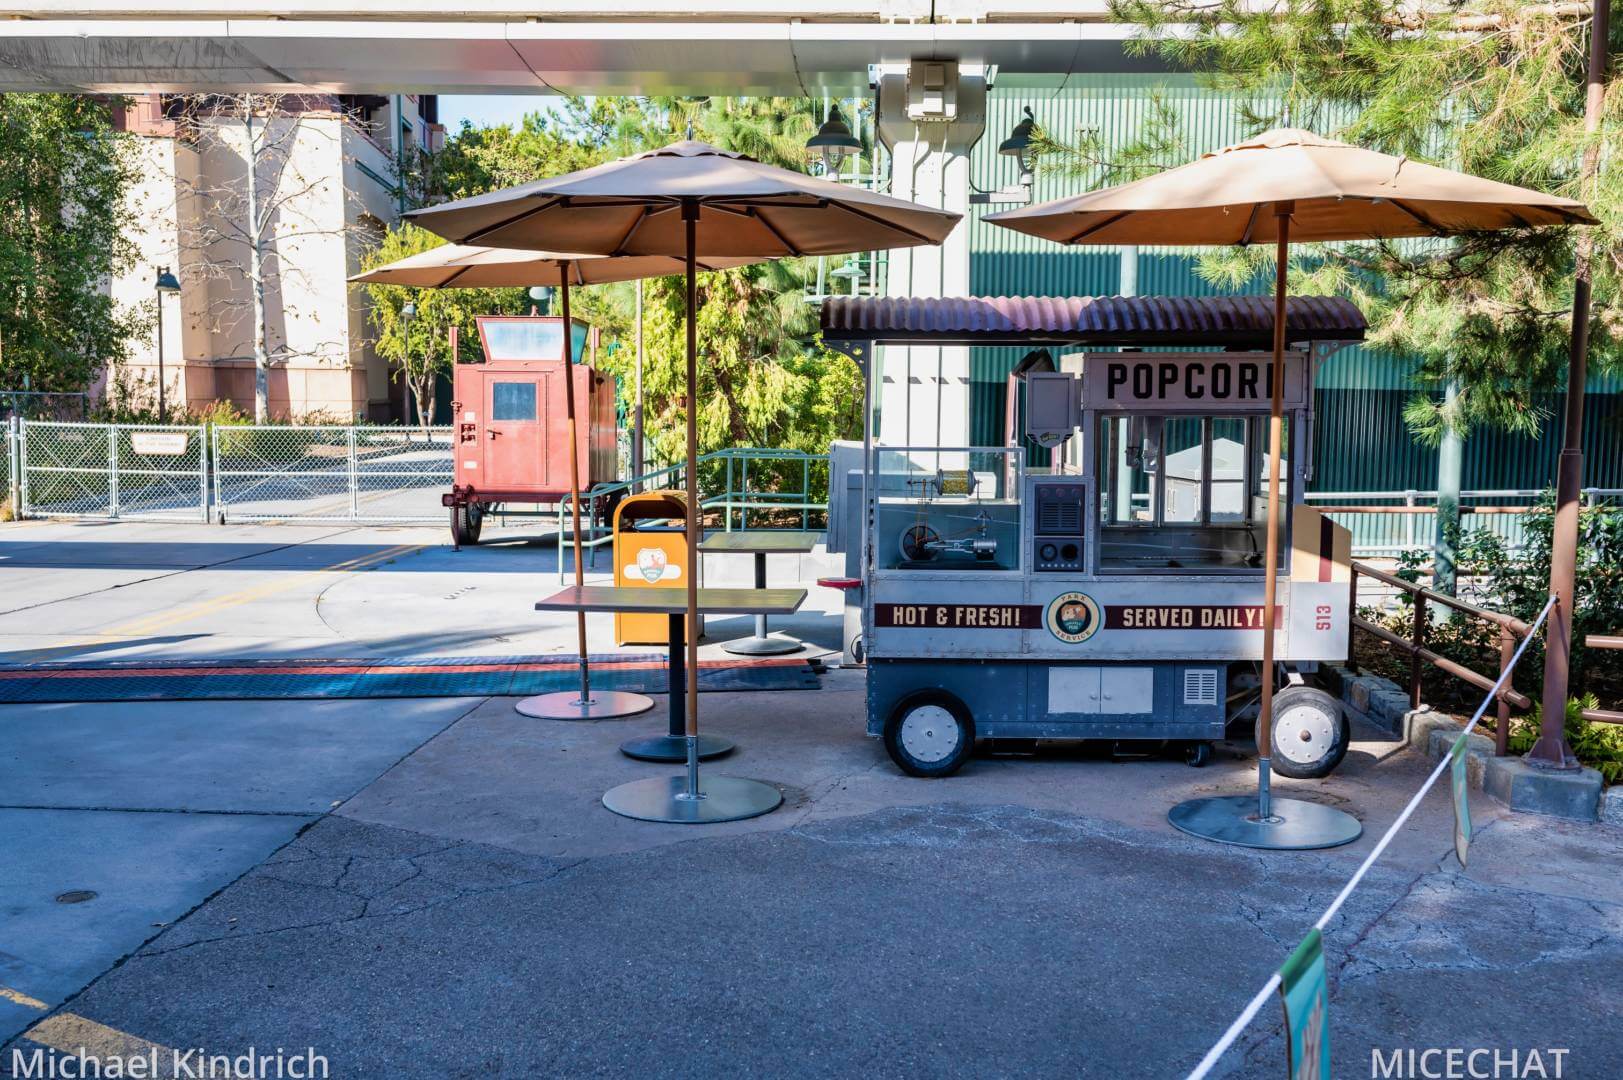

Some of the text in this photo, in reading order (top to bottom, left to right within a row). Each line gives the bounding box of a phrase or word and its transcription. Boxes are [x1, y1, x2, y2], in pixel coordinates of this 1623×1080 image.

[893, 606, 1020, 626] HOT & FRESH!
[1123, 608, 1265, 627] SERVED DAILY!
[1055, 630, 1091, 640] SERVICE
